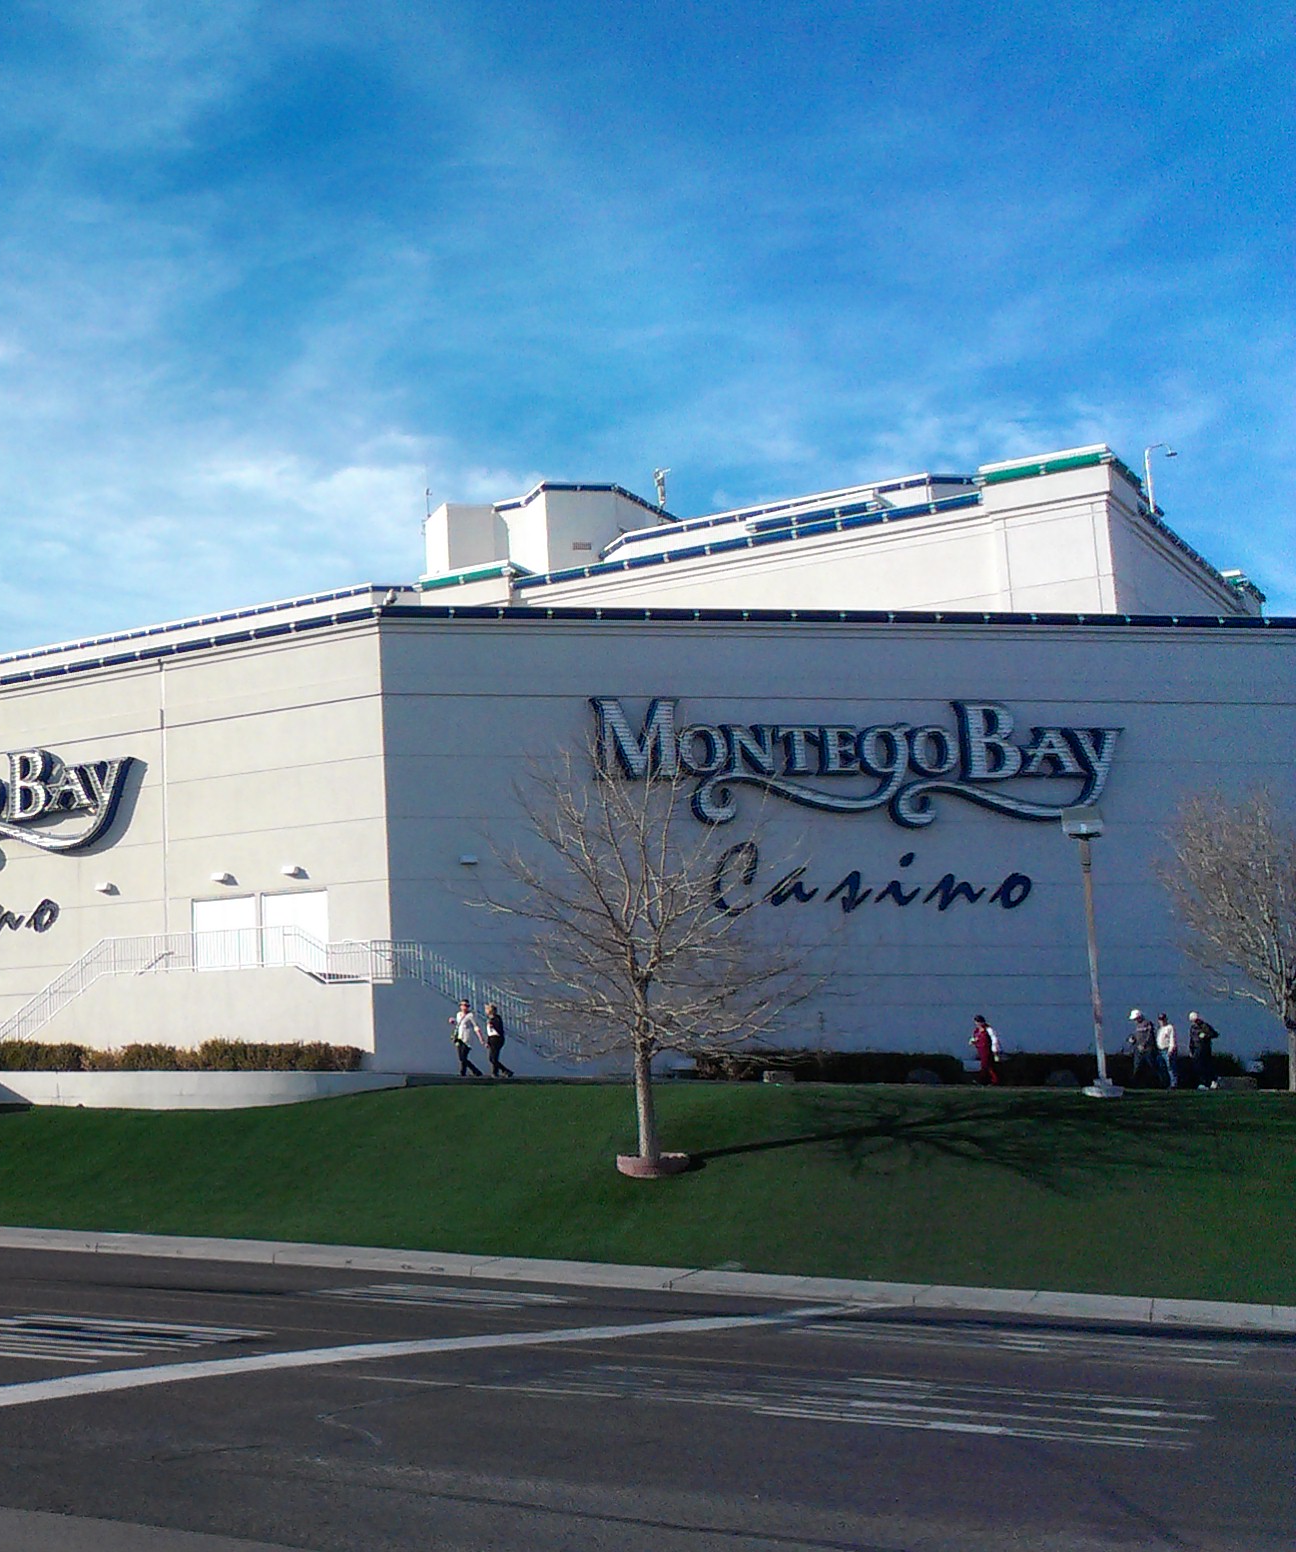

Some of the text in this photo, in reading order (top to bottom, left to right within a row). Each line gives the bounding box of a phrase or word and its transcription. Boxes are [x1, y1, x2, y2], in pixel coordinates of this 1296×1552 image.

[5, 748, 142, 854] BAY
[950, 700, 1125, 822] BAY
[711, 840, 1033, 917] Casino
